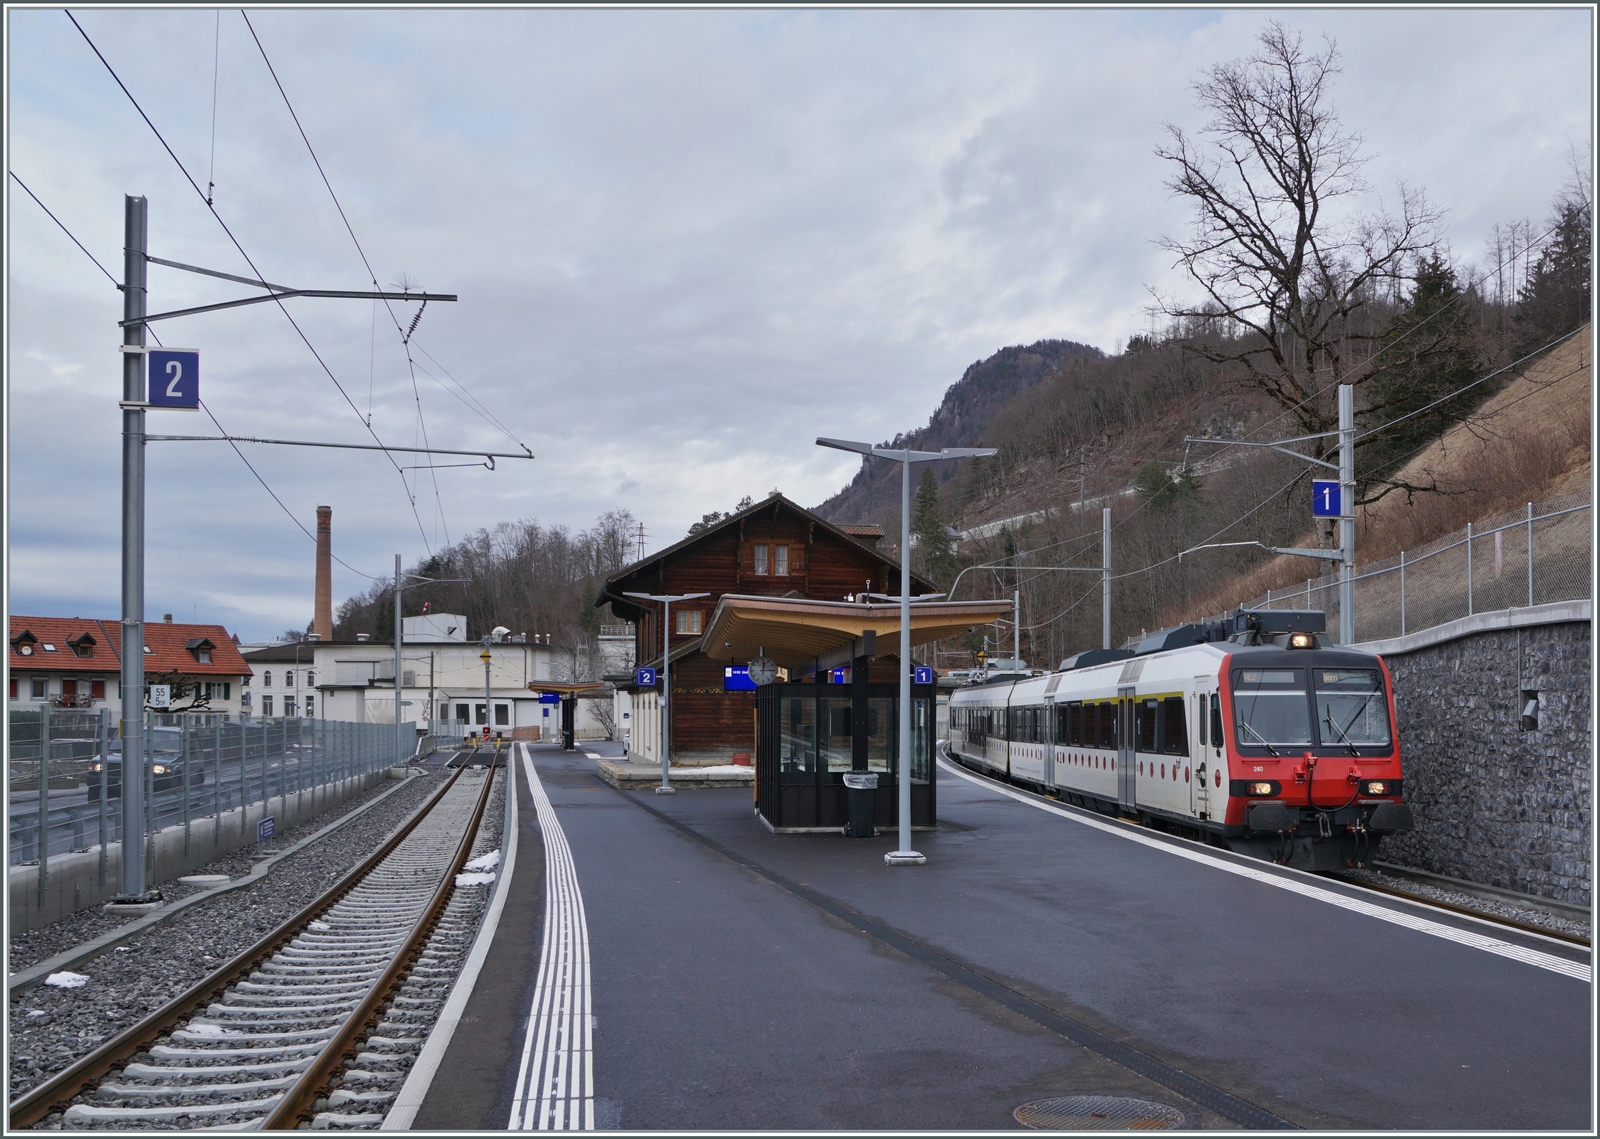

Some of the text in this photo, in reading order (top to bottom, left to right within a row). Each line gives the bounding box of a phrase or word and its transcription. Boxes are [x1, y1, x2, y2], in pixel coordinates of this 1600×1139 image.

[165, 360, 183, 397] 2
[1323, 487, 1330, 510] 1
[643, 673, 650, 682] 2
[921, 672, 926, 681] 1
[1323, 673, 1338, 681] Bern
[156, 688, 165, 696] 55
